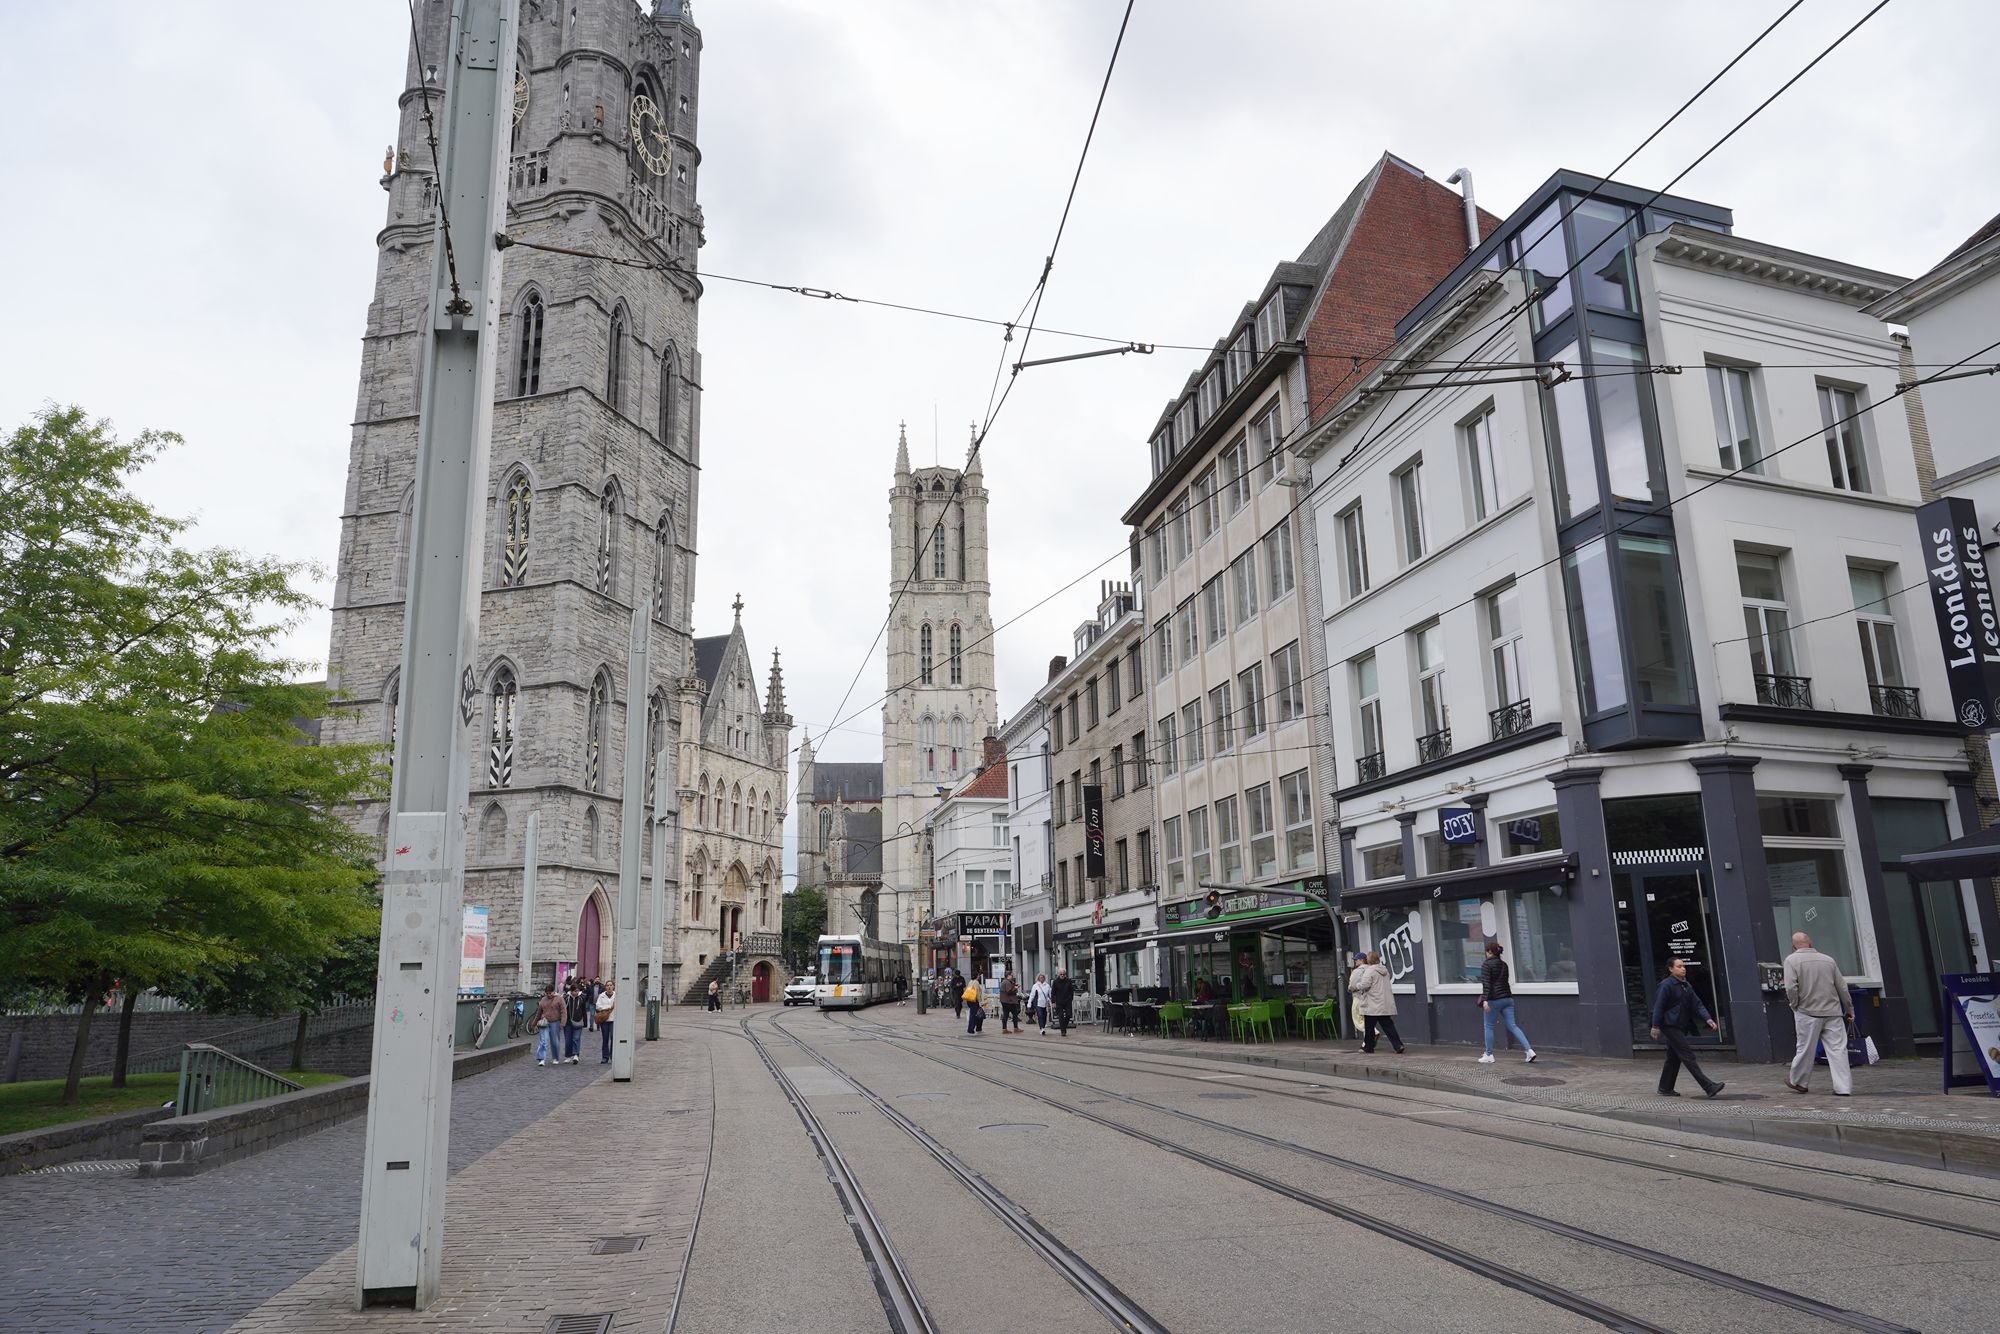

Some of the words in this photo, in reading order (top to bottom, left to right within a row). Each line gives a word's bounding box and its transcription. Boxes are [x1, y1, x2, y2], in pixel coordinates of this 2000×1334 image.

[1931, 527, 1976, 669] Leonidas
[1963, 526, 2000, 663] Leonidas
[1443, 813, 1475, 841] JOEY
[1960, 975, 1990, 984] Leonidas
